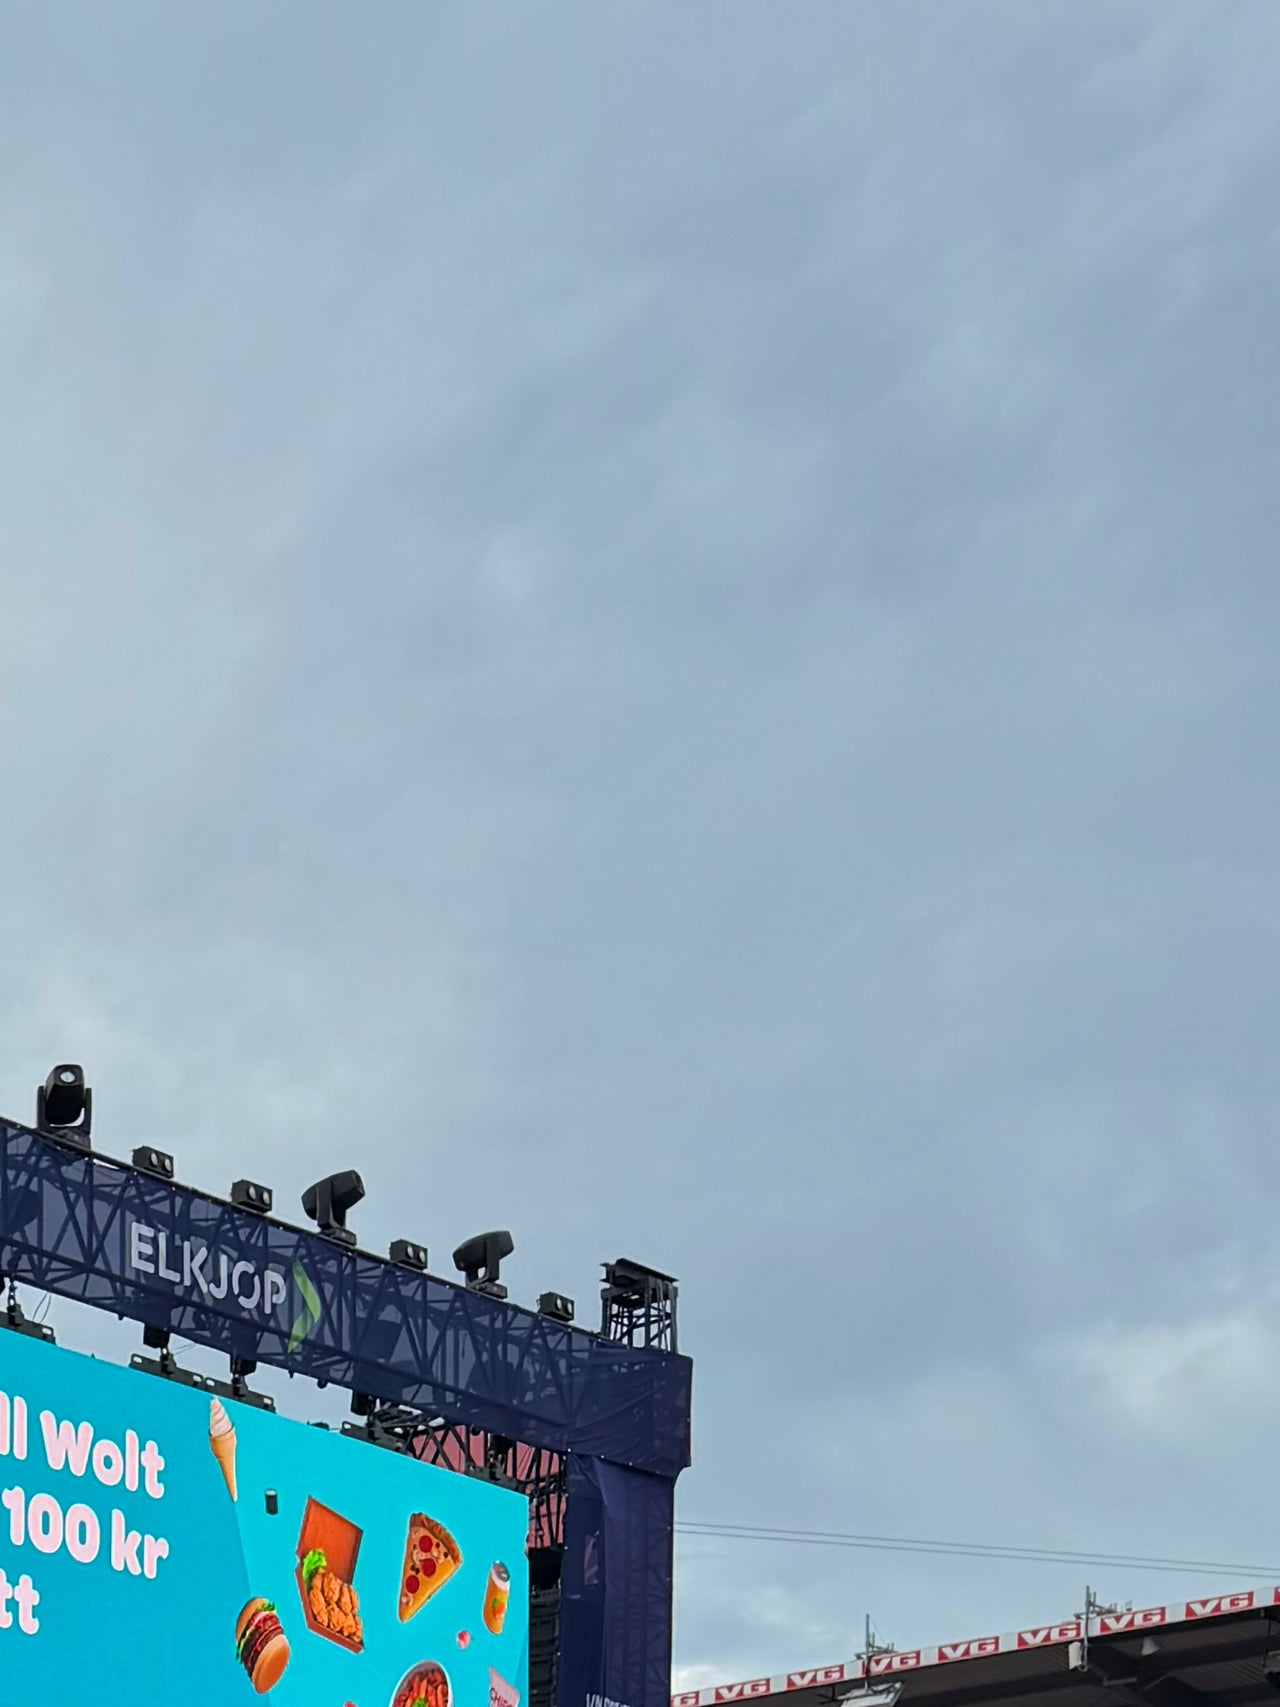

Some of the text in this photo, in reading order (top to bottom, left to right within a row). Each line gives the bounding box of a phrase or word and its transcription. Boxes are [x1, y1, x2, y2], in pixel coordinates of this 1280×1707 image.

[40, 1409, 165, 1500] Wolt
[1, 1484, 101, 1564] 100
[110, 1507, 169, 1580] kr
[1103, 1608, 1165, 1632] VG
[1188, 1593, 1251, 1618] VG
